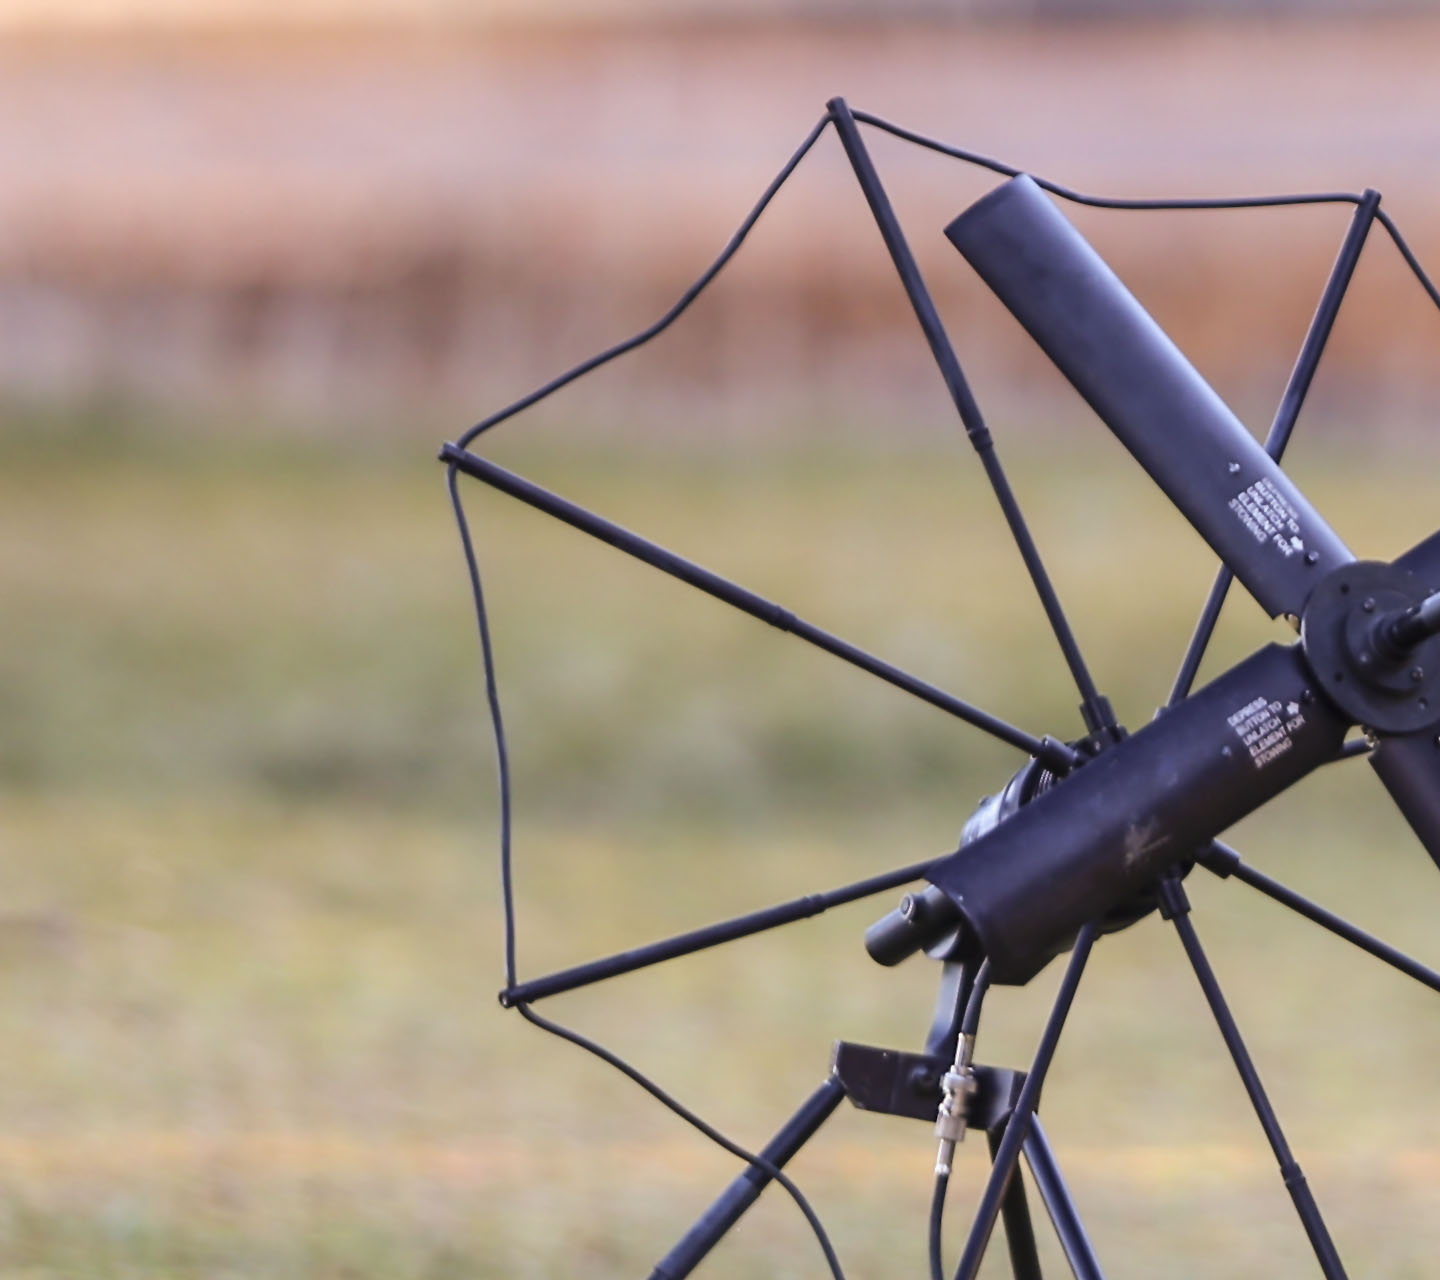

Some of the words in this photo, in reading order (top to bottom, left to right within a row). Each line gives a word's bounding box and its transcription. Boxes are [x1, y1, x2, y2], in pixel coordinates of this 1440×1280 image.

[1228, 498, 1268, 543] STOWING
[1237, 491, 1277, 535] ELEMENT
[1272, 533, 1294, 556] FOR
[1246, 486, 1285, 529] UNLATCH
[1254, 481, 1287, 519] BUTTON
[1287, 518, 1300, 534] TO
[1226, 696, 1268, 727] DEPRESS
[1235, 709, 1270, 737] BUTTON
[1268, 700, 1282, 714] TO
[1242, 716, 1282, 747] UNLATCH
[1248, 725, 1287, 757] ELEMENT
[1286, 713, 1305, 732] FOR
[1254, 736, 1293, 769] STOWING
